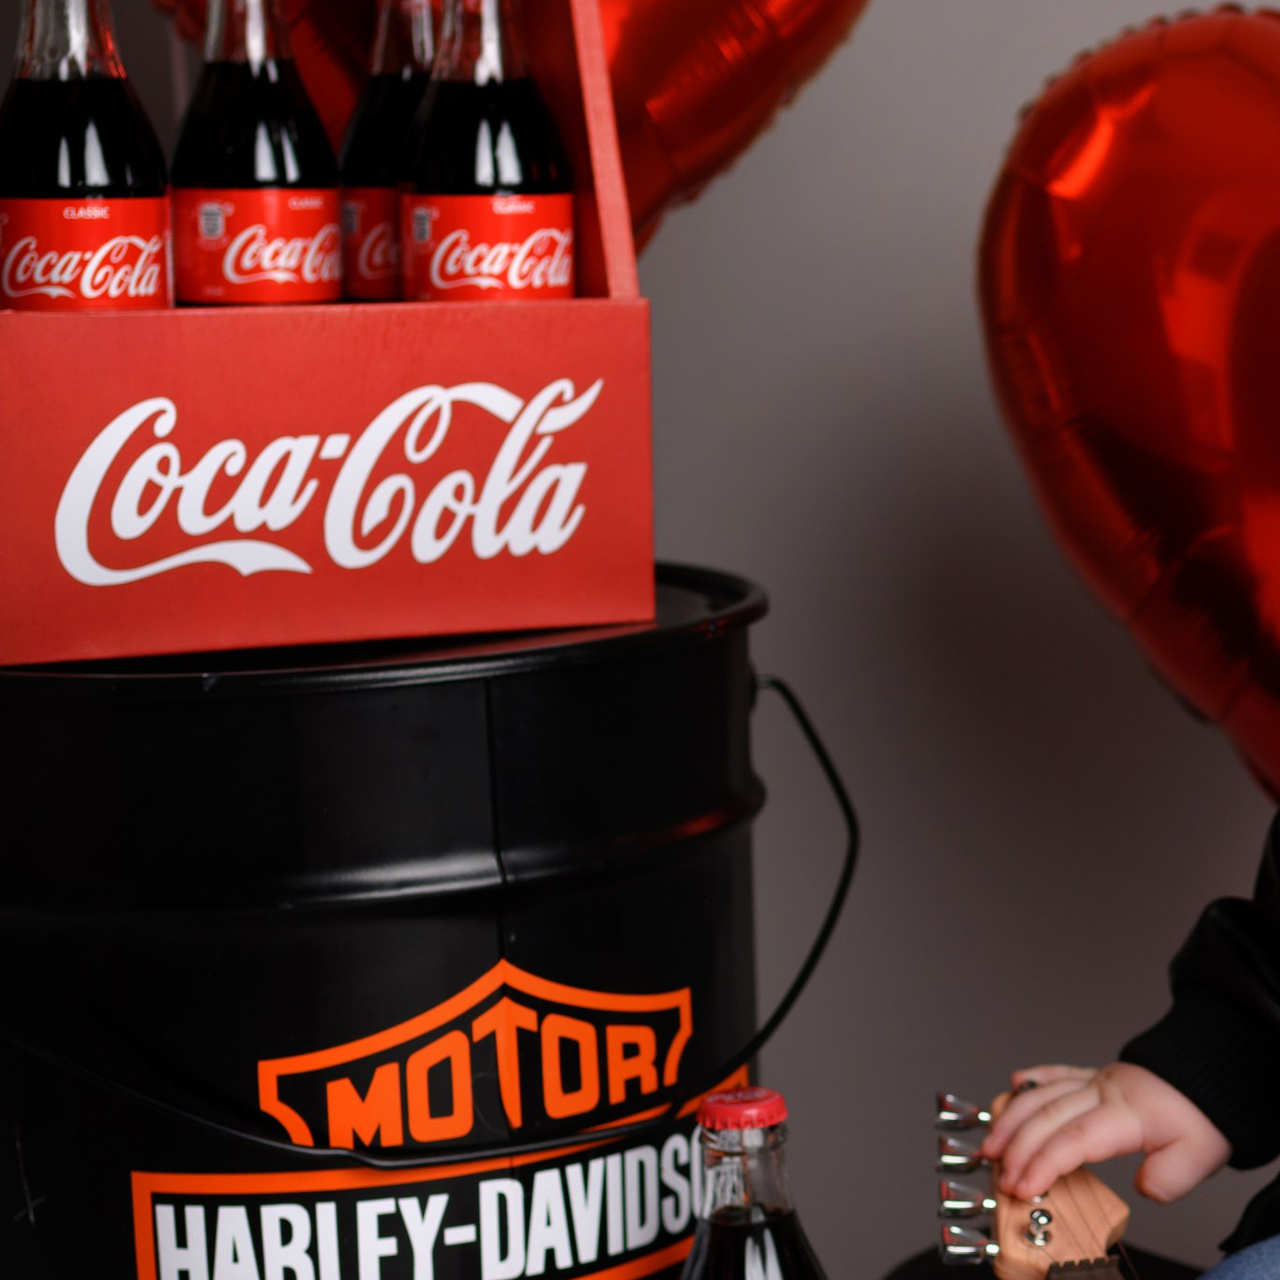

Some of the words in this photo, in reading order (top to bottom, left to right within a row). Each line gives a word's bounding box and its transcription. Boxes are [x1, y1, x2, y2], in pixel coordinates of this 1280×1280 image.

[3, 235, 163, 299] Coca-Cola
[54, 377, 604, 587] Coca-Cola
[326, 996, 658, 1149] MOTOR
